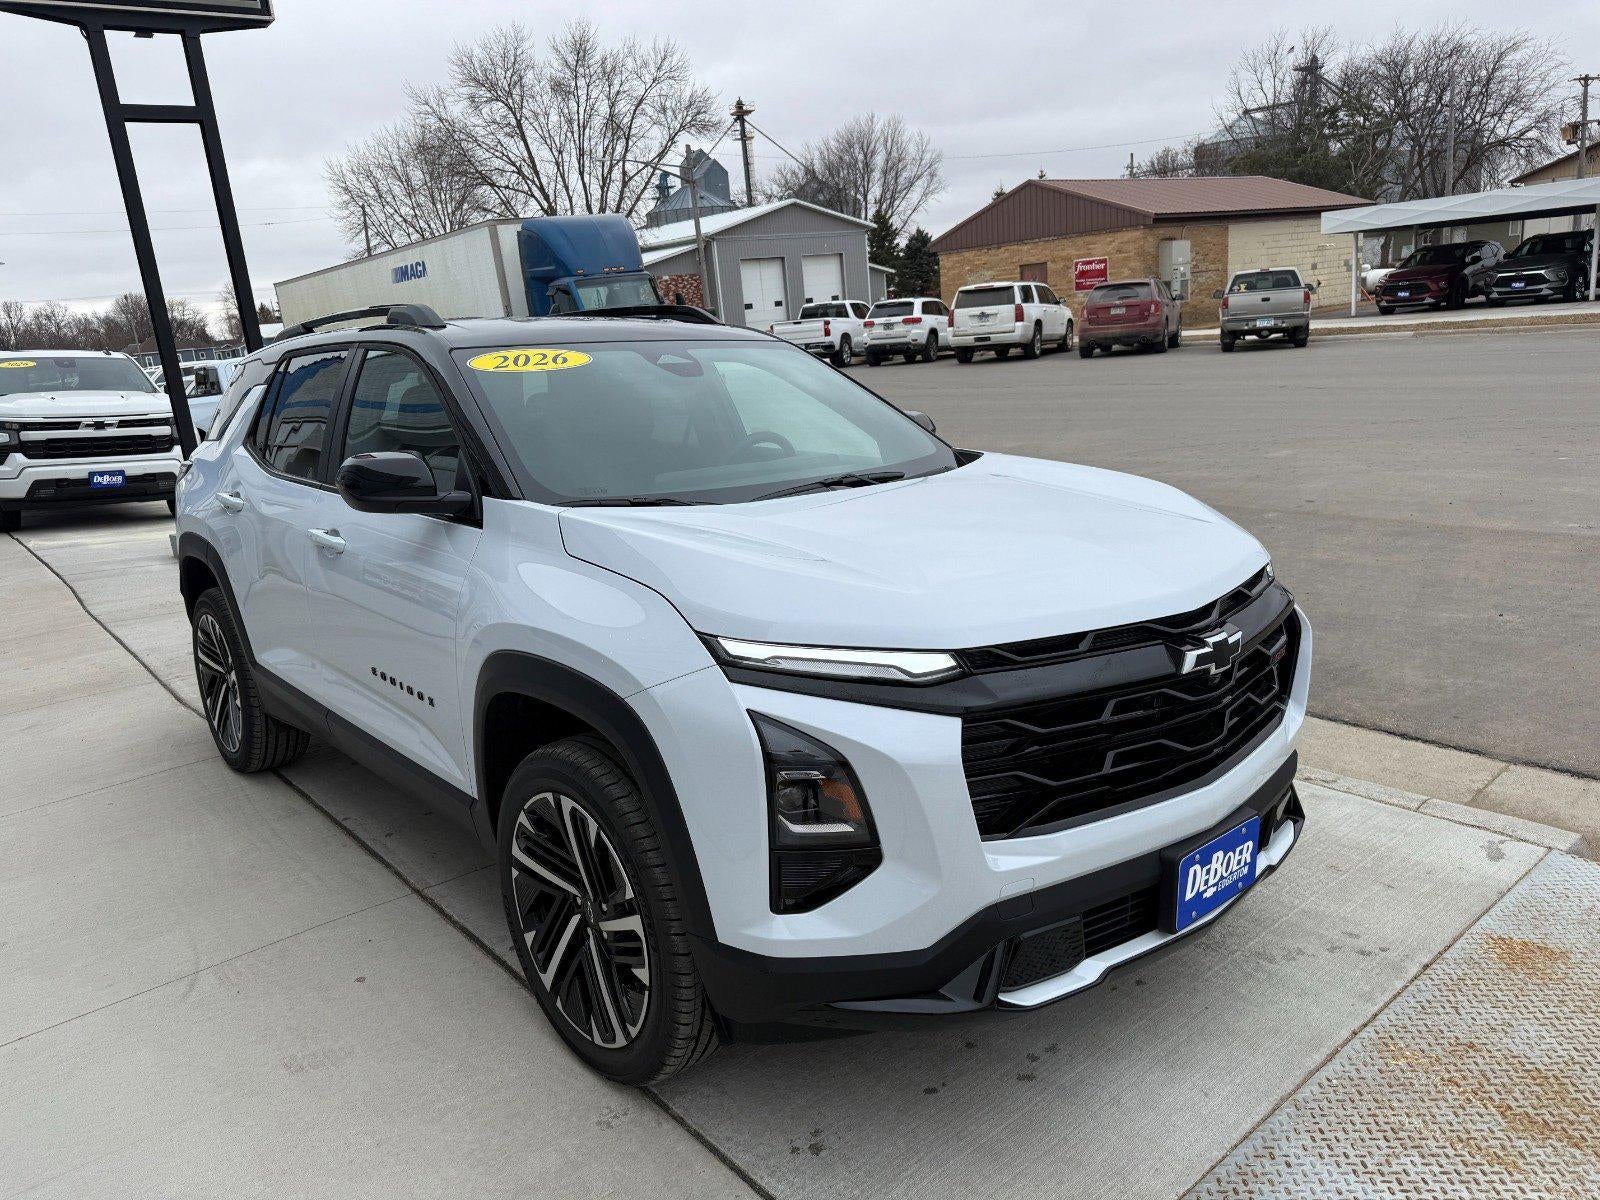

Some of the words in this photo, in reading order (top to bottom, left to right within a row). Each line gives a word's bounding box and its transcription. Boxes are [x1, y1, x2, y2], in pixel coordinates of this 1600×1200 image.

[1075, 261, 1105, 275] frontier
[493, 352, 569, 370] 2026
[371, 666, 435, 708] EQUINOX
[1184, 840, 1254, 902] DEBOER
[1217, 864, 1249, 892] EDGERTON
